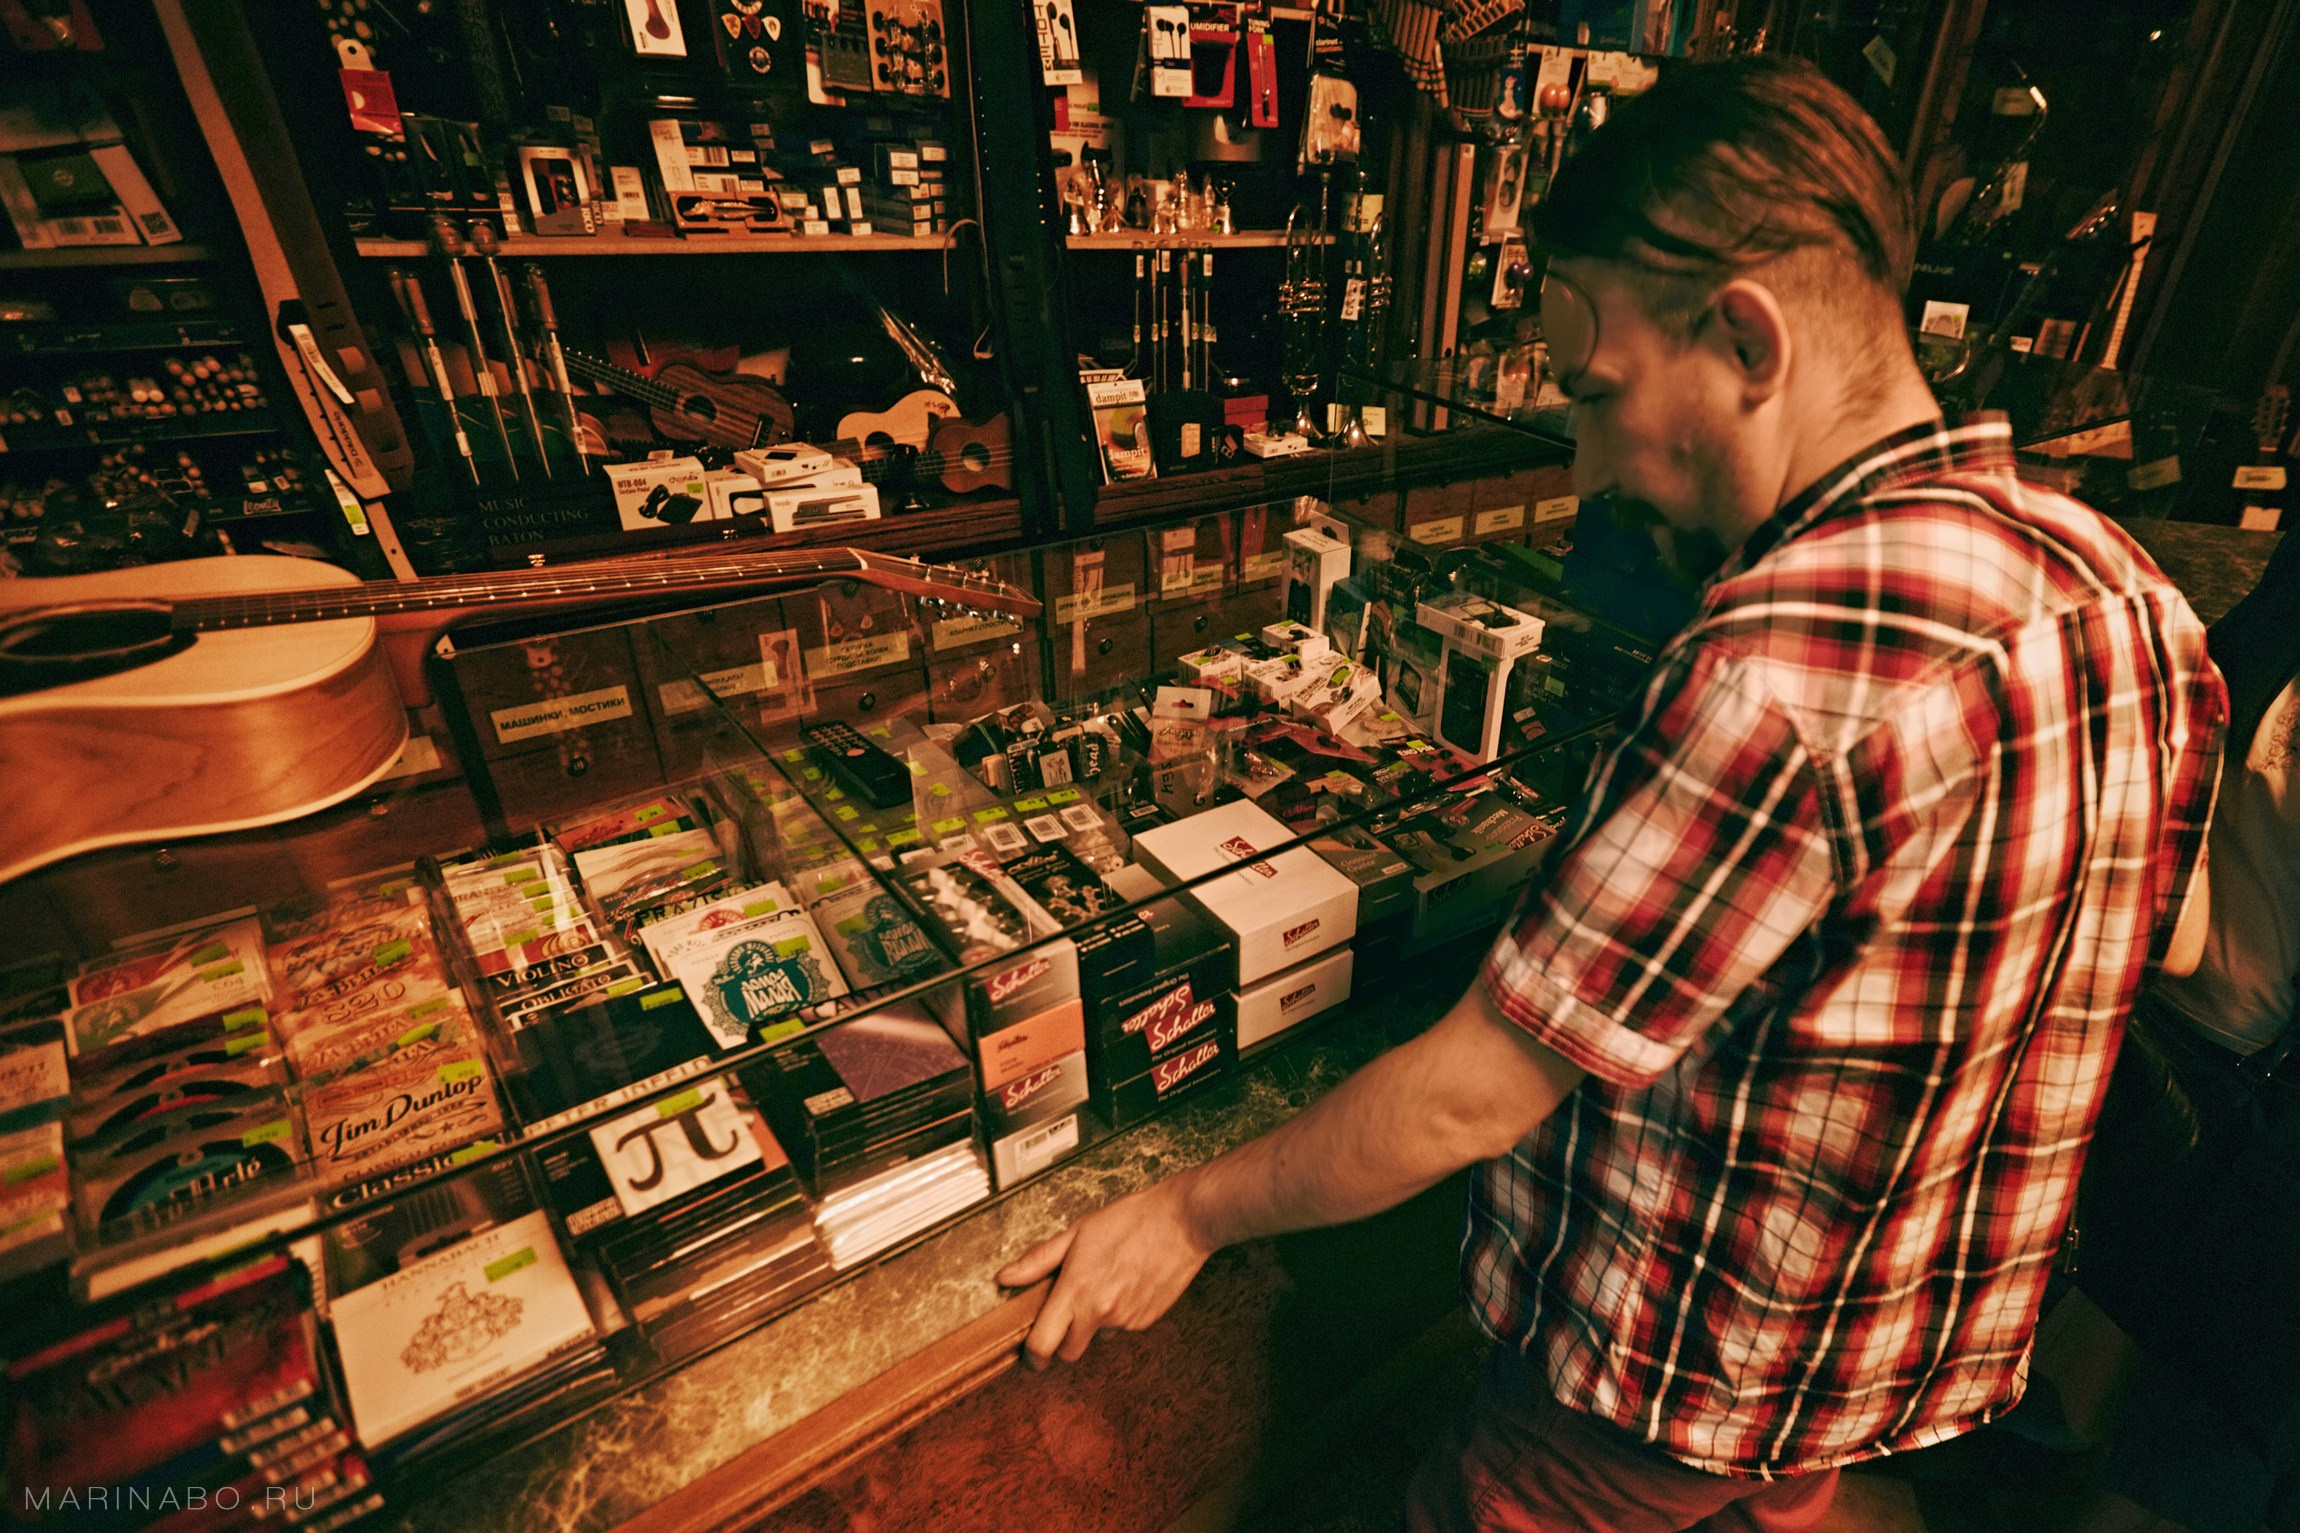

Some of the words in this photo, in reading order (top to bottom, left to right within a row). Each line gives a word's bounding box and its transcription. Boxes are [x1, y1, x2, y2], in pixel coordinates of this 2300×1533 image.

[1034, 4, 1052, 71] TOTEM
[1248, 18, 1271, 29] TUNING
[1248, 26, 1266, 34] FORK
[1152, 14, 1167, 83] TOTM
[581, 207, 596, 234] RICO
[1095, 392, 1127, 406] dampit
[479, 498, 530, 513] MUSIC
[482, 508, 589, 530] CONDUCTING
[489, 530, 544, 547] BATON
[500, 710, 568, 732] МАШИНКИ,
[568, 697, 626, 716] МОСТИКИ
[1221, 836, 1273, 879] Schller
[1284, 919, 1320, 946] Schaller
[496, 952, 590, 988] VIOLINO
[990, 957, 1051, 1002] Schaller
[520, 973, 612, 1011] OBLIGATO
[1121, 984, 1190, 1033] Schaller
[1151, 1003, 1217, 1051] Schaller
[1005, 1064, 1062, 1109] Schaller
[1158, 1044, 1220, 1092] Schaller
[320, 1117, 381, 1163] Jim
[381, 1074, 485, 1131] Dunlop
[382, 1232, 501, 1290] HANNABACH
